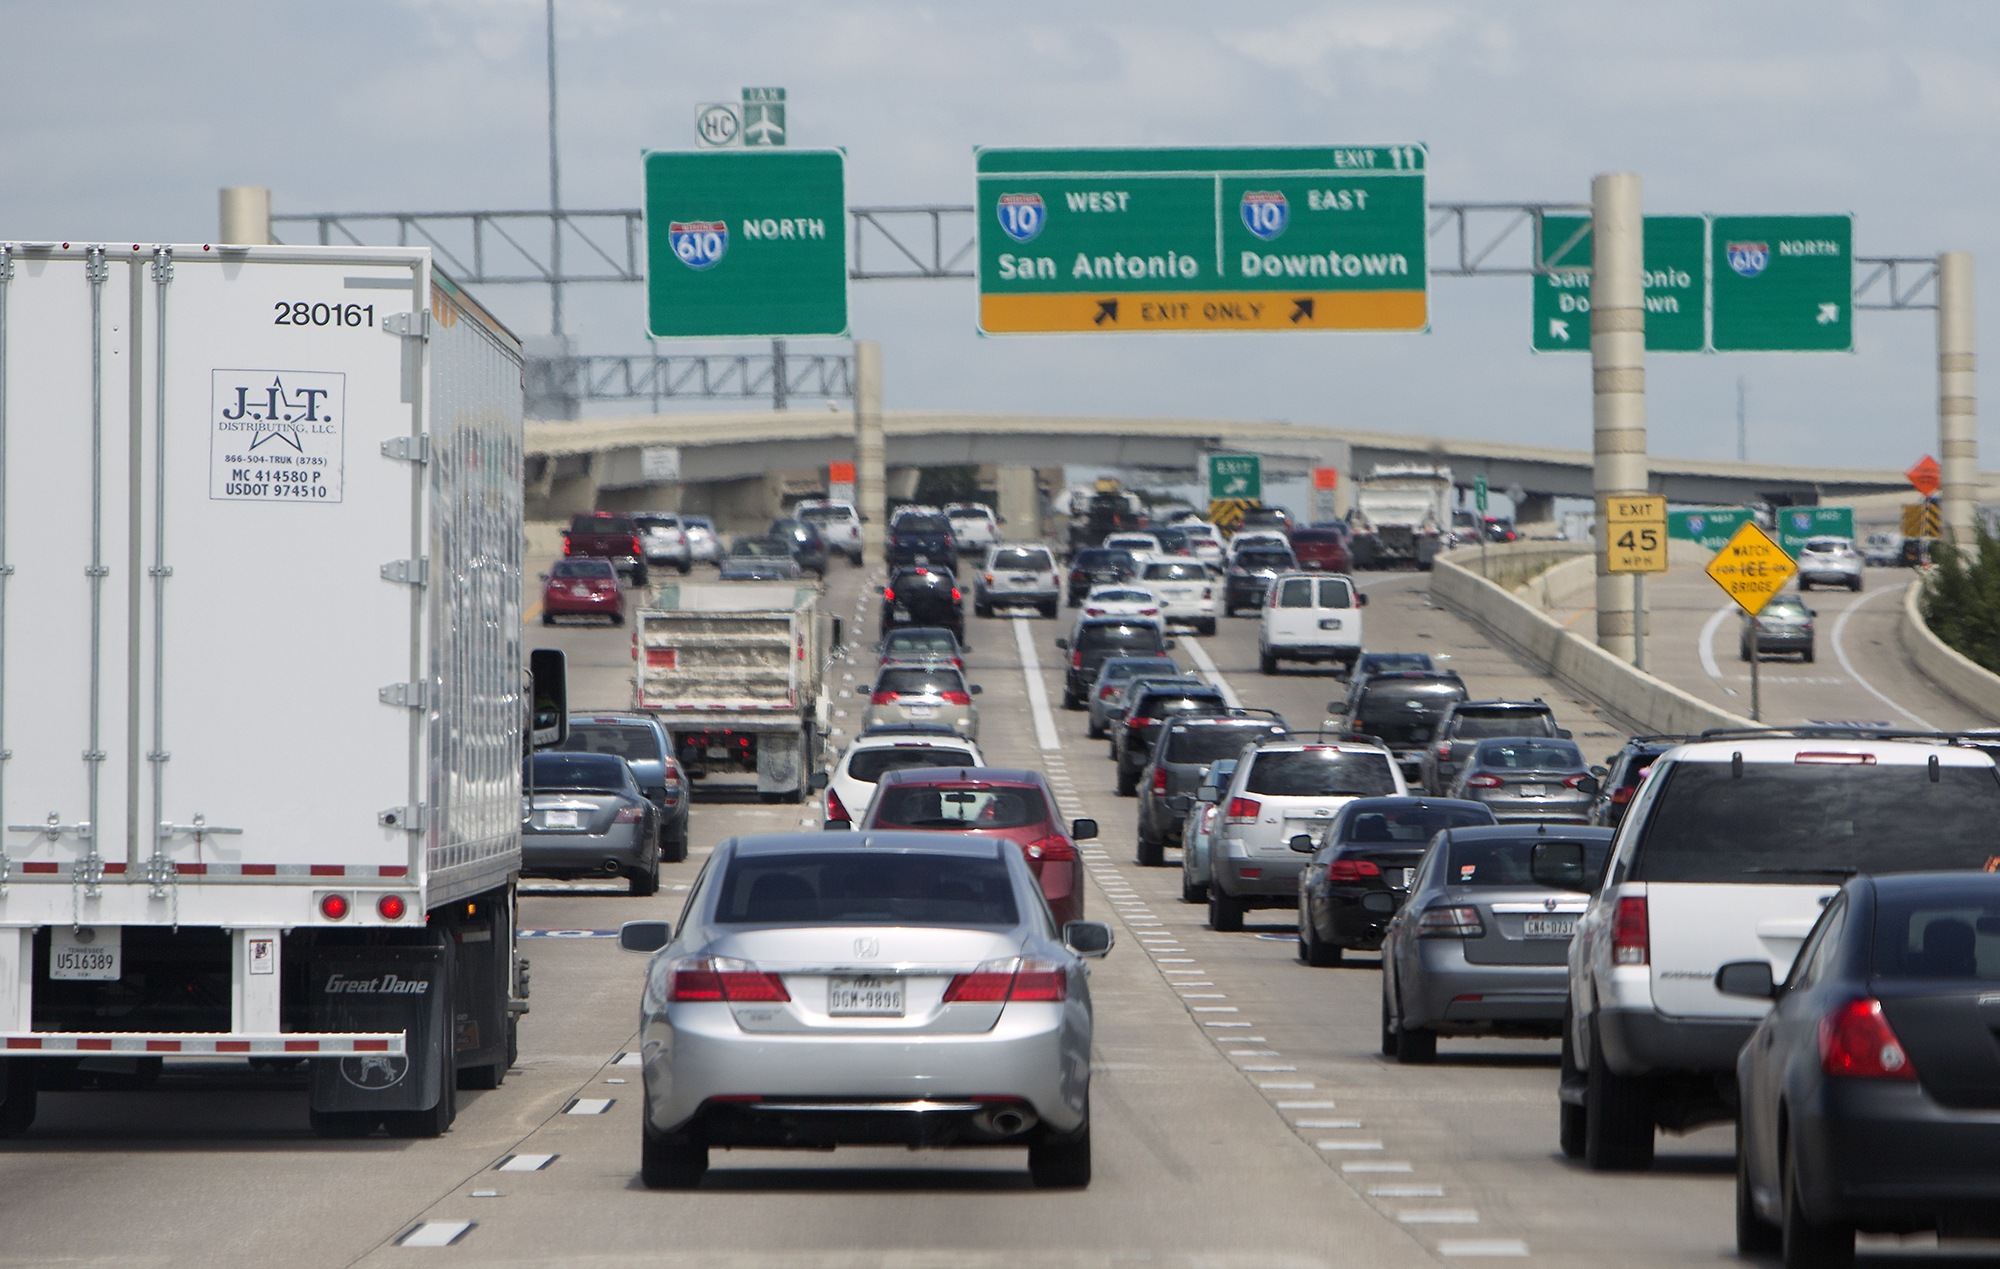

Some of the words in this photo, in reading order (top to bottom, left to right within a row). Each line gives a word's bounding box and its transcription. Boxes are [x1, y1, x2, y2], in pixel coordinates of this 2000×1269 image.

[705, 115, 732, 137] HC
[1334, 149, 1377, 169] EXIT
[1389, 145, 1416, 171] 11
[1065, 191, 1130, 212] WEST
[1308, 189, 1369, 211] EAST
[1007, 205, 1038, 233] 10
[1251, 202, 1280, 230] 10
[743, 218, 826, 240] NORTH
[677, 232, 722, 260] 610
[1779, 240, 1840, 257] NORTH
[999, 253, 1057, 280] San
[1072, 251, 1199, 279] Antonio
[1241, 251, 1408, 279] Downtown
[1548, 271, 1591, 289] San
[1642, 265, 1692, 289] onio
[1141, 302, 1191, 322] EXIT
[1203, 301, 1265, 322] ONLY
[1559, 292, 1680, 314] Down
[274, 301, 374, 328] 280161
[222, 386, 332, 423] J.I.T.
[218, 421, 308, 434] DISTRIBUTING,
[311, 424, 337, 434] LLC.
[224, 454, 293, 465] 866-504-TRUK
[295, 456, 328, 467] (8785)
[1217, 460, 1252, 475] EXIT
[232, 468, 251, 481] MC
[255, 469, 308, 483] 414580
[313, 471, 322, 483] P
[226, 483, 269, 496] USDOT
[274, 484, 327, 498] 974510
[1619, 503, 1653, 516] EXIT
[1617, 529, 1658, 551] 45
[1732, 544, 1771, 557] WATCH
[1622, 555, 1653, 566] MPH
[1716, 564, 1735, 574] FOR
[1741, 561, 1769, 577] ICE
[1773, 564, 1787, 573] ON
[1731, 580, 1773, 594] BRIDGE
[57, 953, 114, 970] U516389
[325, 974, 379, 993] Great
[378, 974, 429, 994] Dane
